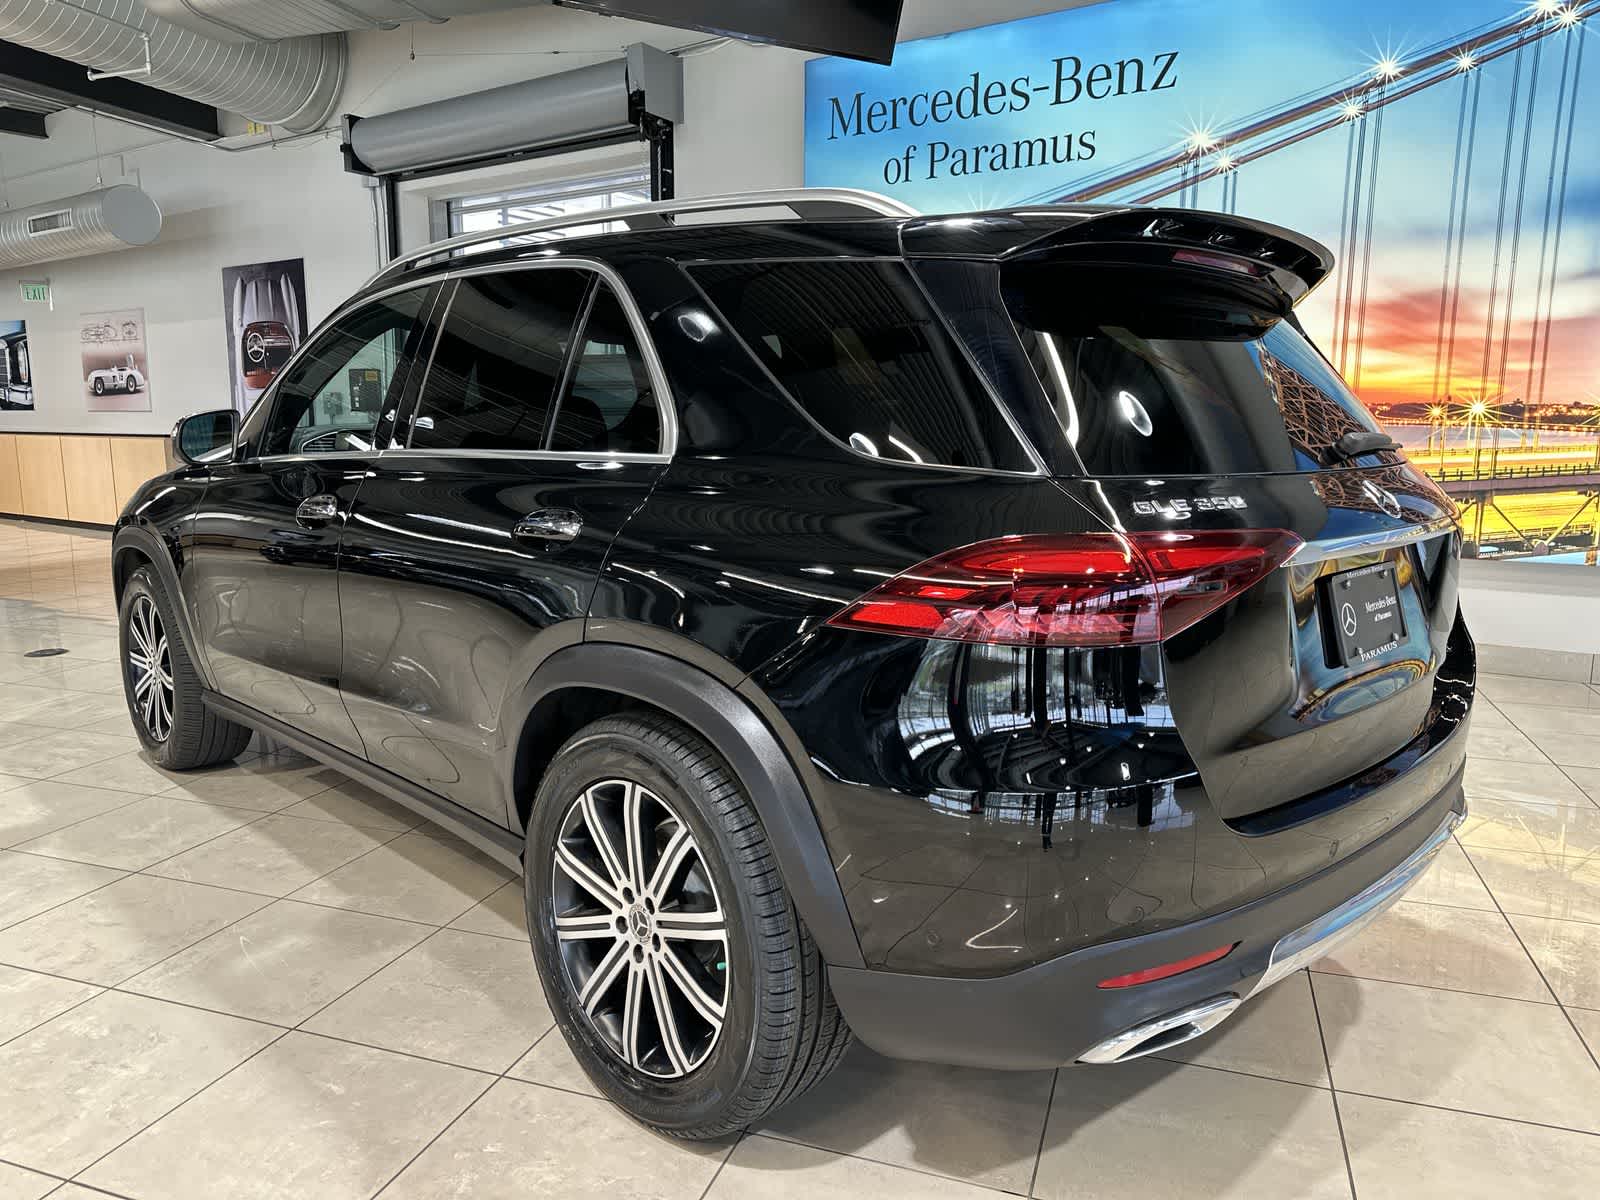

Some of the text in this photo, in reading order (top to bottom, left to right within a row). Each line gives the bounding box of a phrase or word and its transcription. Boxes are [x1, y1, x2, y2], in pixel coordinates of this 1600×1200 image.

[827, 51, 1179, 140] Mercedes-Benz
[884, 130, 1097, 185] of Paramus
[25, 286, 46, 301] EXIT
[1133, 496, 1248, 515] GLE 350
[1361, 640, 1398, 662] PARAMUS
